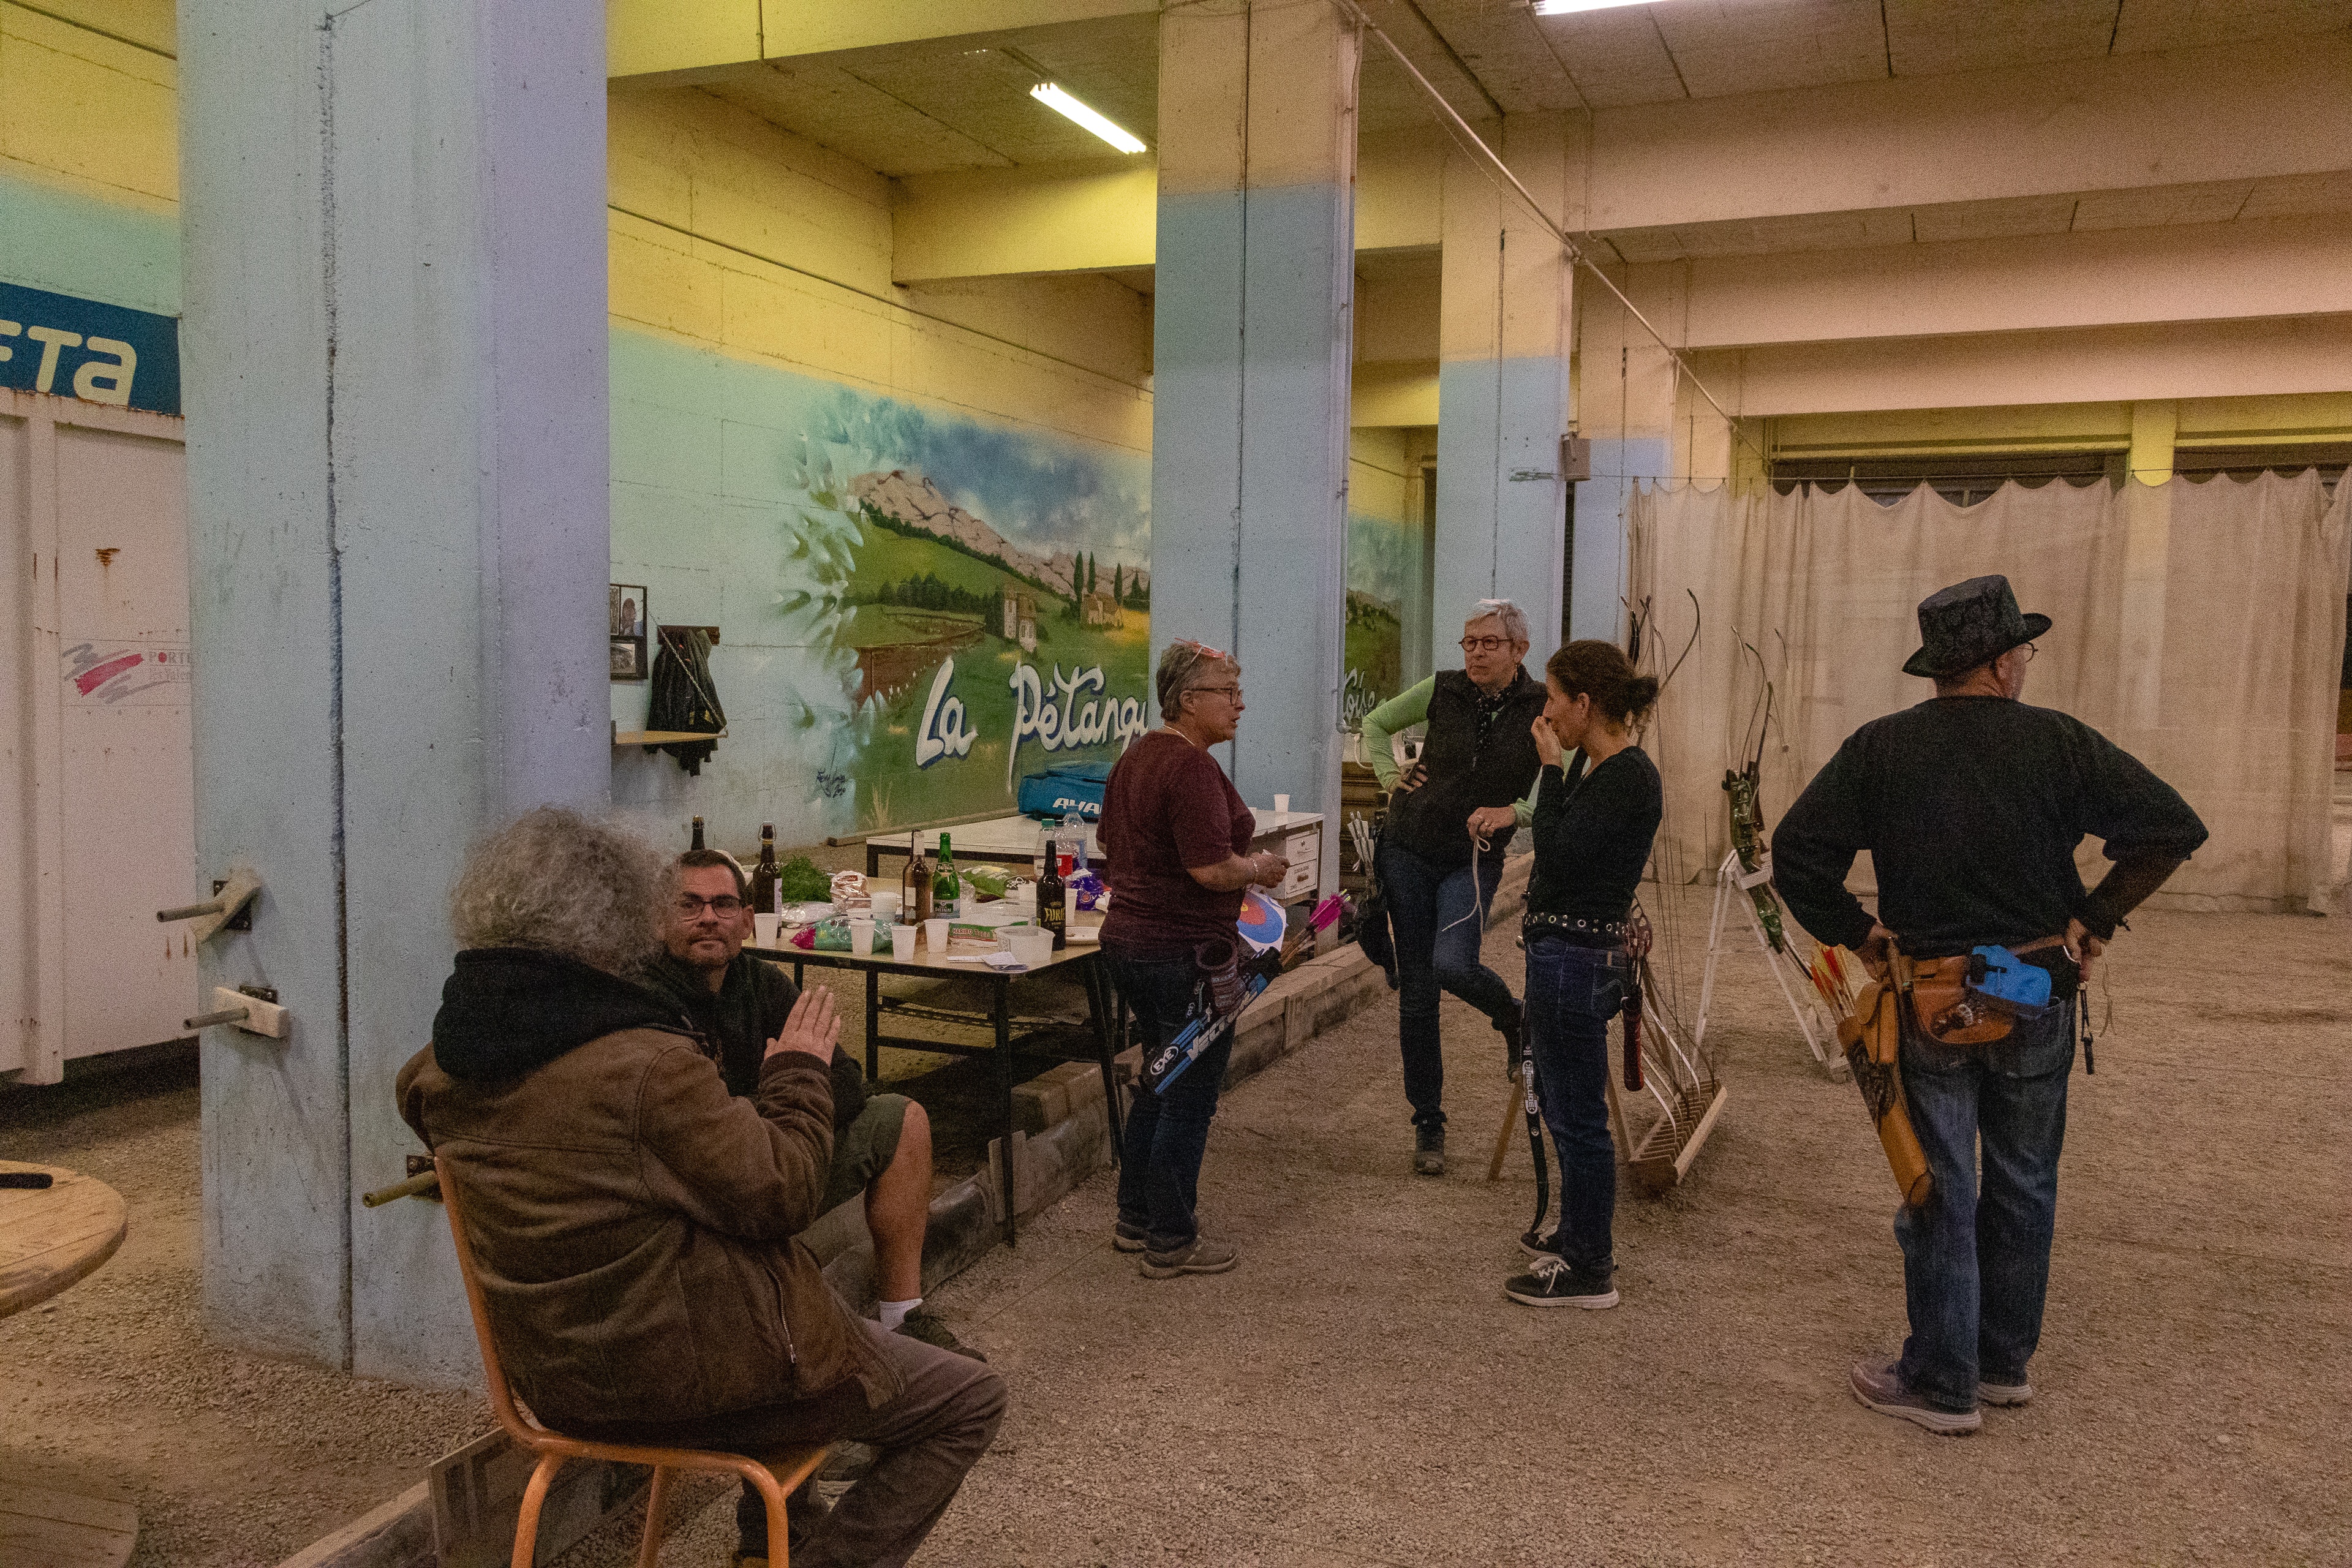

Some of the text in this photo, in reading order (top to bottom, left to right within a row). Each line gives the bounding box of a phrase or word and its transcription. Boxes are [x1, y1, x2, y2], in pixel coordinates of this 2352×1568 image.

[0, 318, 137, 406] Ta
[916, 657, 978, 767] La
[1052, 797, 1102, 815] AVA
[1153, 1049, 1175, 1072] EXE
[1525, 1066, 1535, 1108] PRELUDE
